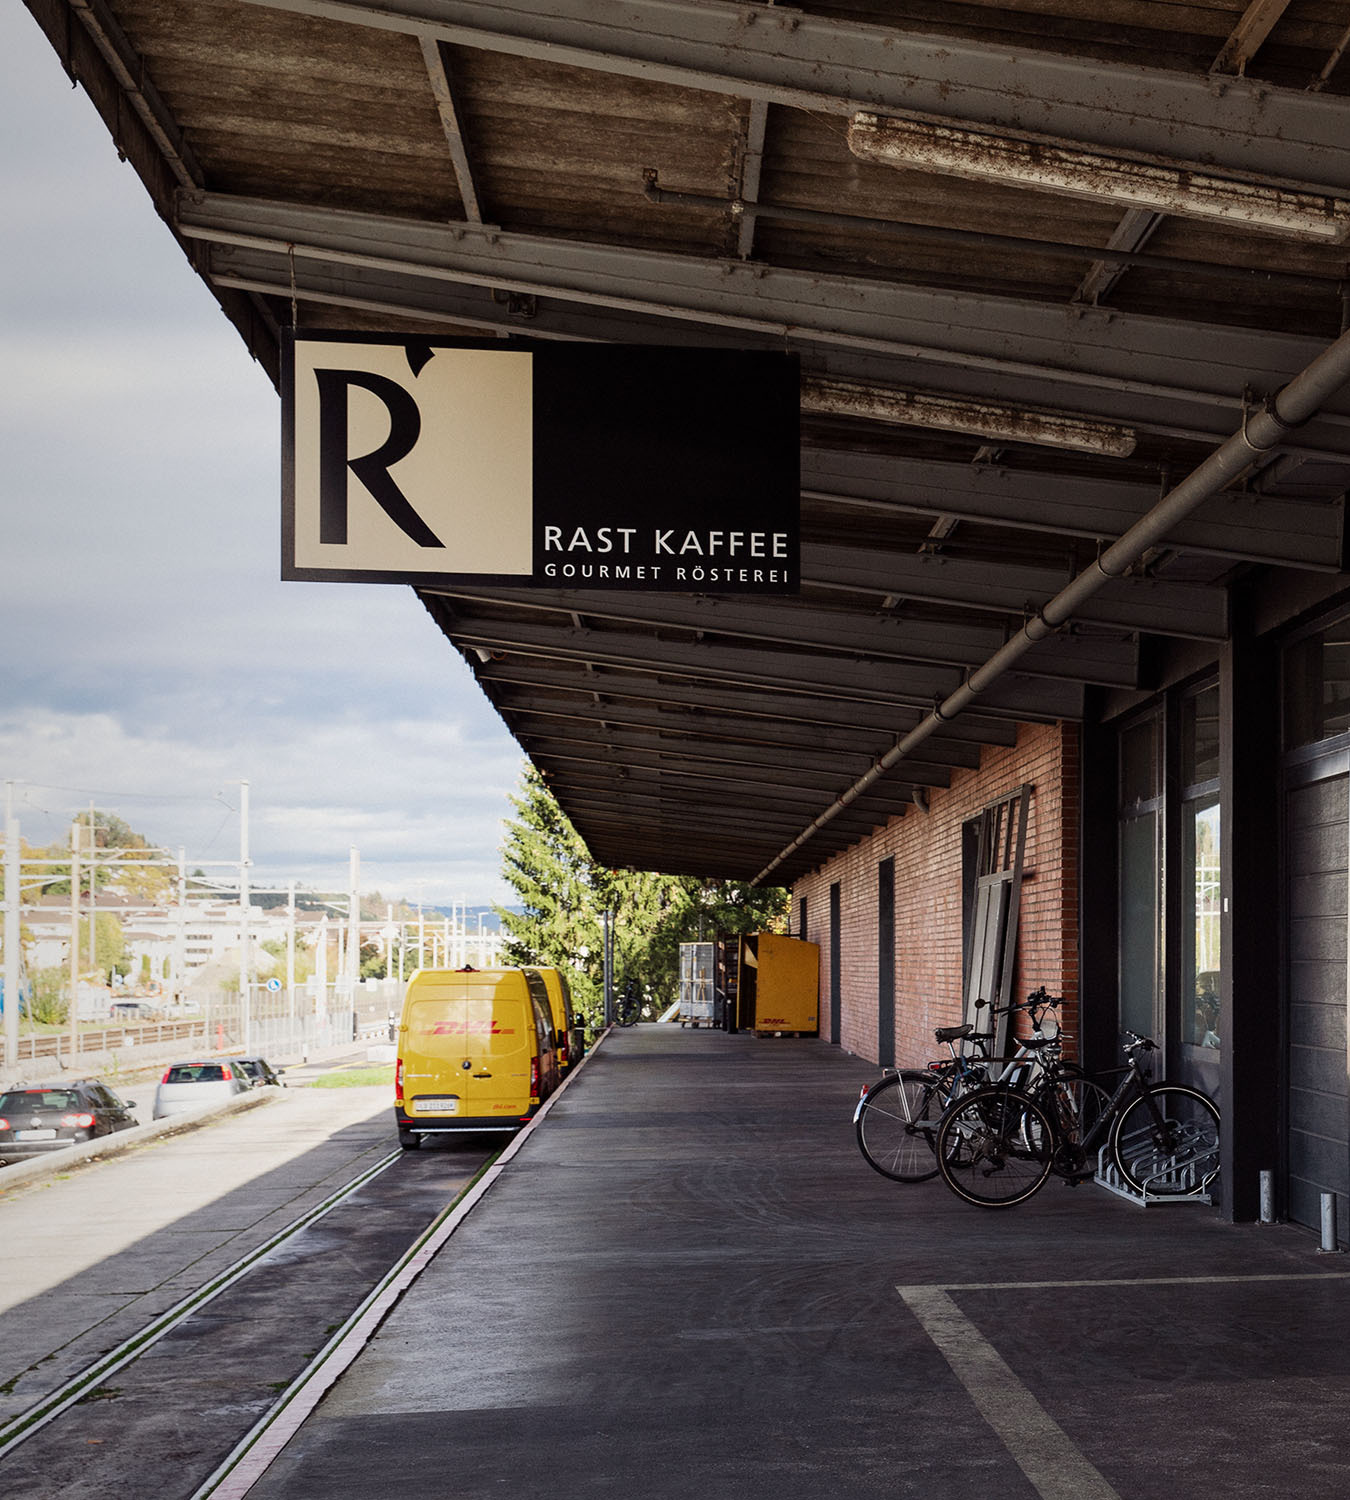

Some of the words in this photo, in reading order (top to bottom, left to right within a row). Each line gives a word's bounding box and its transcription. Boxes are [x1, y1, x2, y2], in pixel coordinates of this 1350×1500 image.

[544, 525, 637, 554] RAST
[655, 529, 789, 558] KAFFEE
[544, 563, 662, 580] GOURMET
[676, 564, 789, 583] RÖSTEREI
[433, 1021, 502, 1035] DHL
